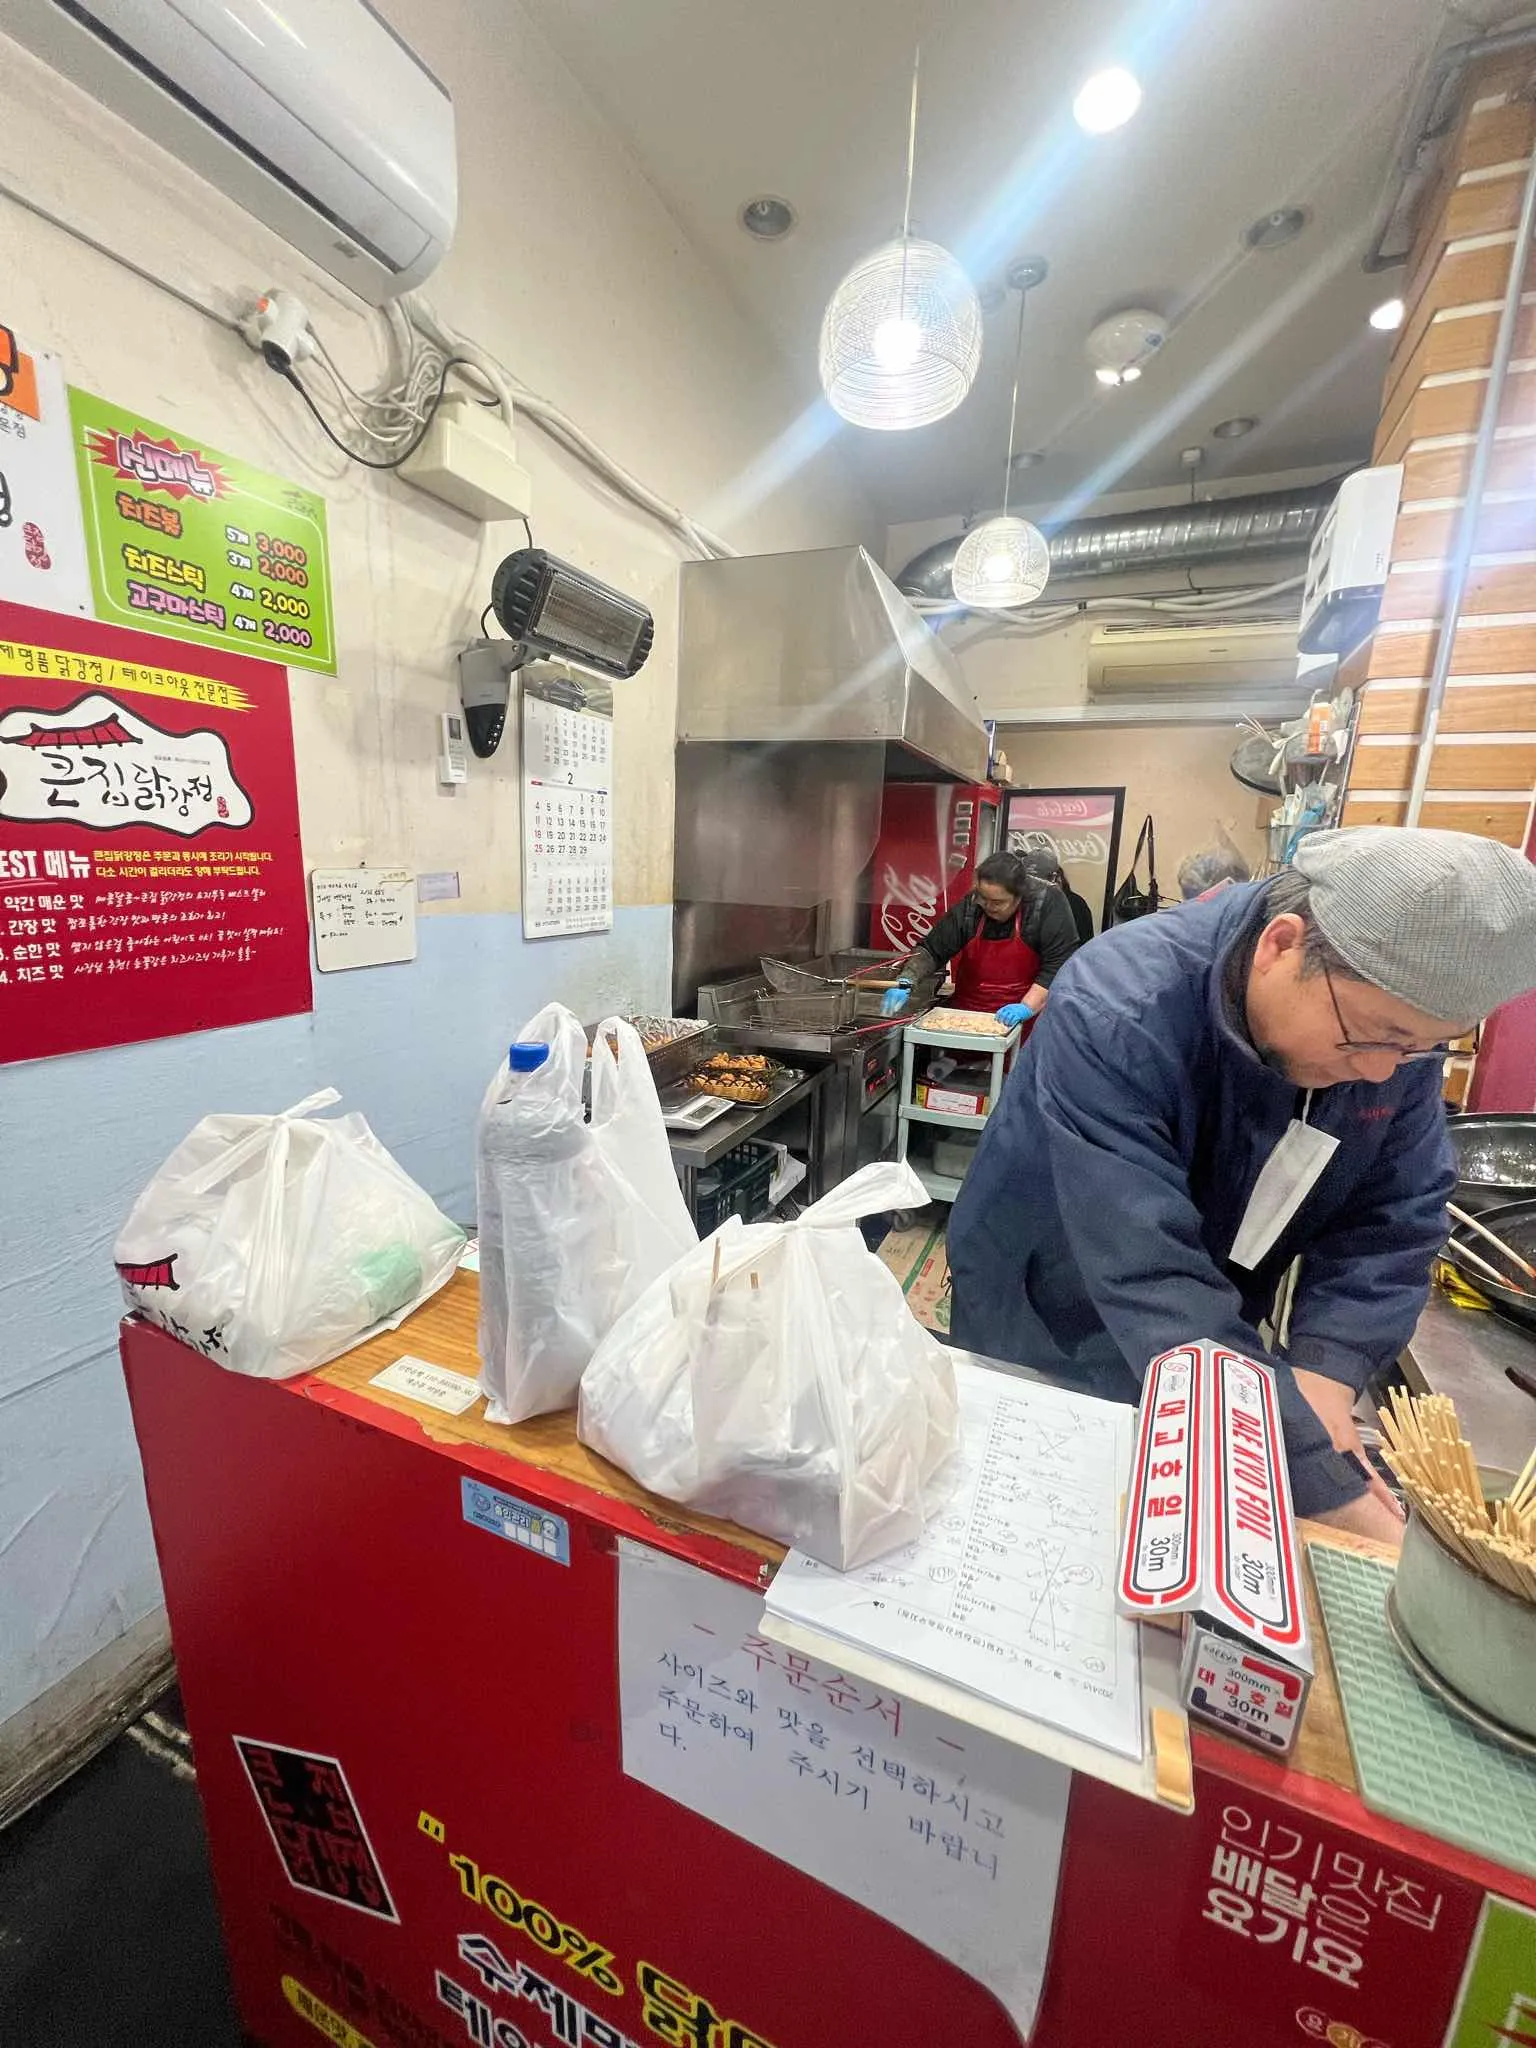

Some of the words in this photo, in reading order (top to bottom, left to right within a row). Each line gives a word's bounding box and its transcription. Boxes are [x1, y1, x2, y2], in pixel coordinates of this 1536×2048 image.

[117, 434, 215, 496] 신메뉴
[116, 491, 183, 538] 치즈볼
[256, 532, 307, 566] 3,000
[122, 543, 206, 593] 치즈스틱
[260, 588, 309, 619] 2,000
[258, 555, 308, 588] 2,000
[127, 580, 226, 630] 고구마스틱
[263, 620, 312, 648] 2,000
[18, 648, 49, 673] 명품
[55, 654, 102, 683] 닭강정
[122, 667, 190, 699] 테이크아웃
[193, 681, 229, 704] 전문점
[567, 772, 574, 785] 2
[43, 850, 90, 878] 메뉴
[95, 867, 117, 877] 다소
[119, 867, 147, 877] 시간이
[4, 896, 35, 912] 약간
[38, 895, 67, 911] 매운
[69, 894, 84, 909] 맛
[8, 919, 38, 935] 간장
[42, 918, 56, 933] 맛
[13, 944, 43, 960] 순한
[46, 943, 61, 957] 맛
[16, 966, 46, 982] 치즈
[49, 965, 64, 979] 맛
[1231, 1407, 1263, 1449] DAE
[1147, 1399, 1186, 1518] 대교호일
[1233, 1443, 1267, 1490] KYO
[1235, 1485, 1272, 1542] FOIL
[1147, 1537, 1170, 1572] 30m
[1242, 1552, 1264, 1596] 30m
[741, 1632, 902, 1739] 주문순서
[1228, 1668, 1271, 1693] 300mm
[1227, 1695, 1269, 1723] 30m
[657, 1651, 758, 1714] 사이즈와
[778, 1707, 830, 1750] 맛을
[851, 1745, 1005, 1840] 선택하시고
[658, 1686, 754, 1752] 주문하여
[789, 1751, 870, 1811] 주시기
[909, 1815, 998, 1882] 바랍니
[1221, 1806, 1442, 1932] 인기맛집
[1211, 1845, 1370, 1947] 배달은
[449, 1852, 623, 1996] 100%
[1202, 1888, 1363, 1989] 요기요
